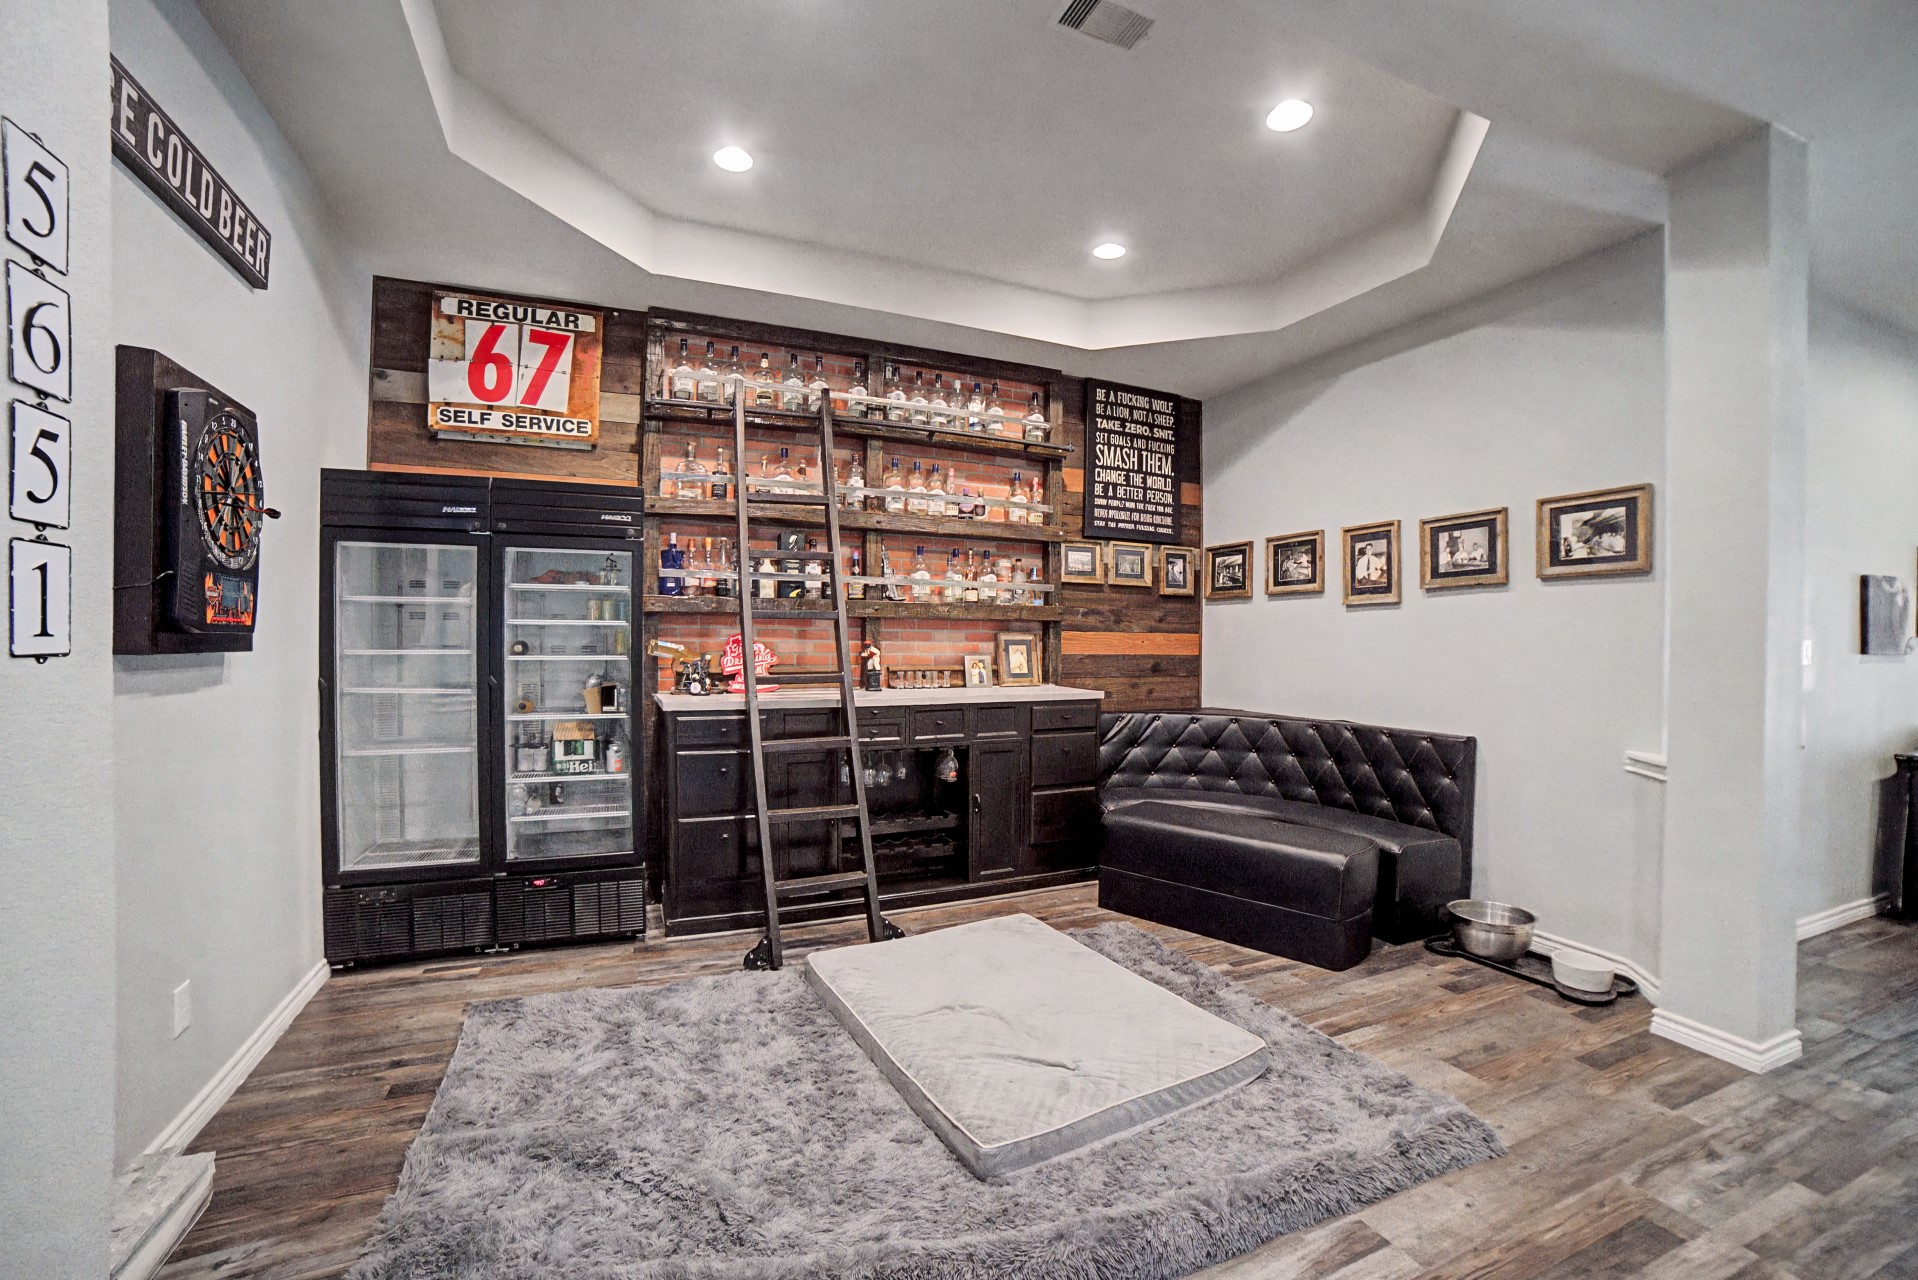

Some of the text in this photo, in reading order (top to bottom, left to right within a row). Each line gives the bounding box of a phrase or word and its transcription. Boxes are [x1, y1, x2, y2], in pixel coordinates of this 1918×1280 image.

[22, 160, 56, 238] 5
[147, 112, 214, 220] COLD
[218, 188, 268, 277] BEER
[457, 299, 580, 329] REGULAR
[23, 301, 61, 374] 6
[467, 324, 571, 406] 67
[1096, 388, 1176, 414] BE A FUCKING WOLF.
[1096, 403, 1176, 428] BE A LION, NOT A SHEEP.
[439, 408, 589, 435] SELF SERVICE
[1096, 418, 1175, 441] TAKE. ZERO. SHIT.
[1096, 432, 1174, 454] SET GOALS AND FUCKING
[26, 429, 60, 503] 5
[1096, 444, 1174, 476] SMASH THEM.
[1094, 484, 1104, 496] BE
[1108, 484, 1114, 496] A
[1116, 486, 1144, 500] BETTER
[1095, 468, 1126, 484] CHANGE
[1129, 472, 1144, 486] THE
[31, 561, 54, 637] 1
